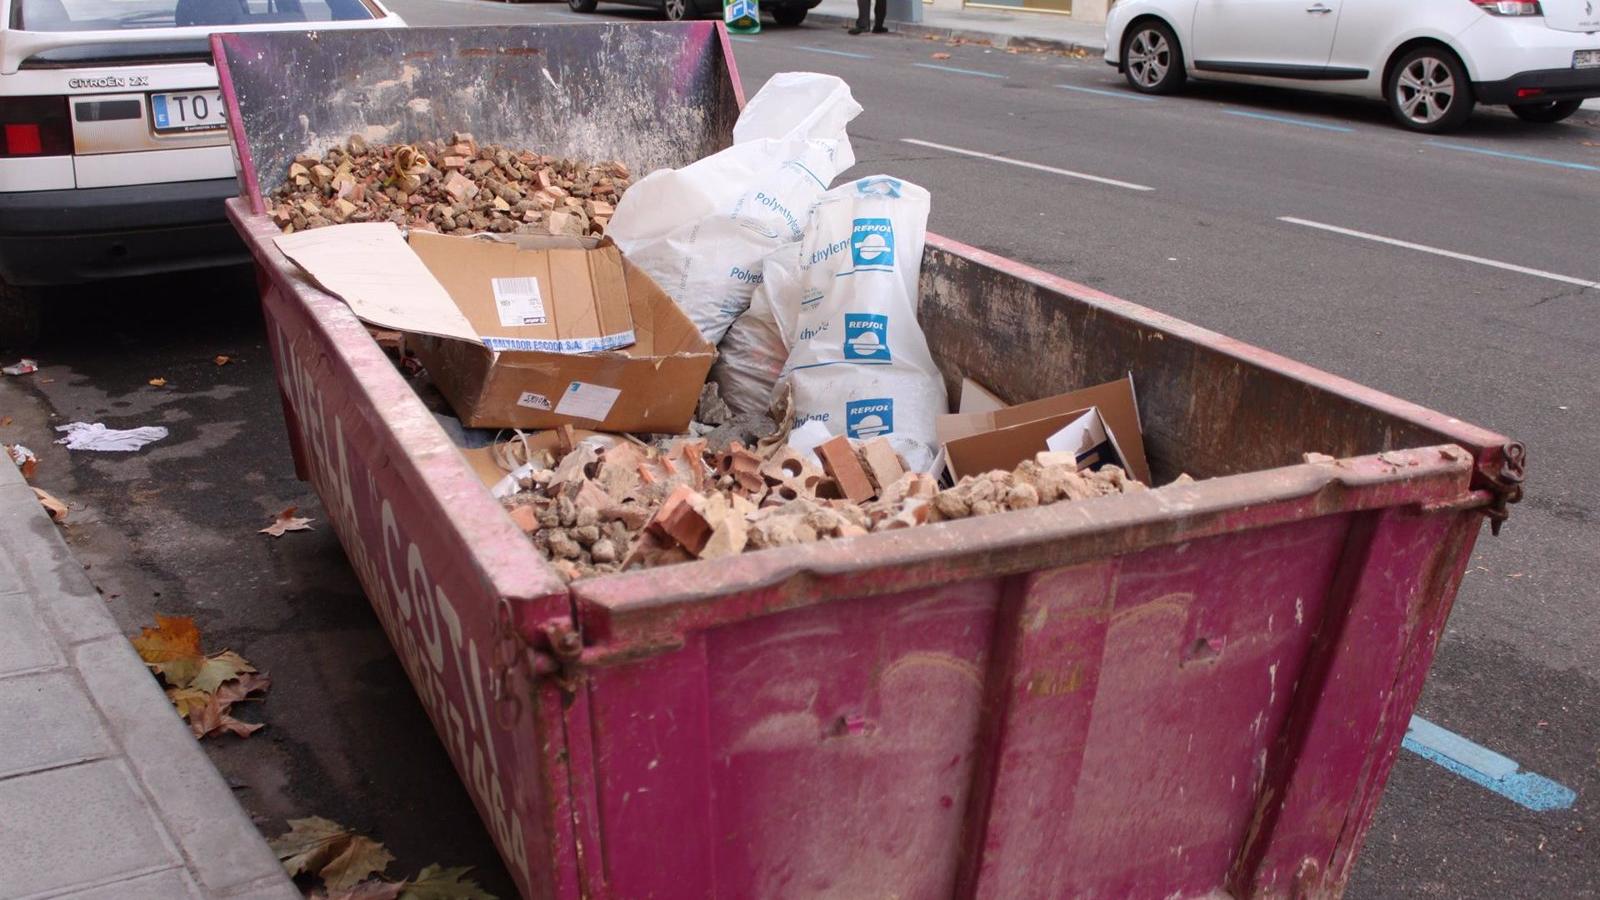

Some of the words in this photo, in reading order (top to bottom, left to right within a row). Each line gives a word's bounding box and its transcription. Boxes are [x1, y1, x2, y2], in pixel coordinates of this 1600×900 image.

[69, 76, 126, 89] CITROËN
[129, 75, 149, 87] ZX
[172, 93, 209, 122] TO
[848, 320, 884, 330] REPSOL
[534, 341, 563, 352] ESCODA
[850, 404, 889, 415] REPSOL
